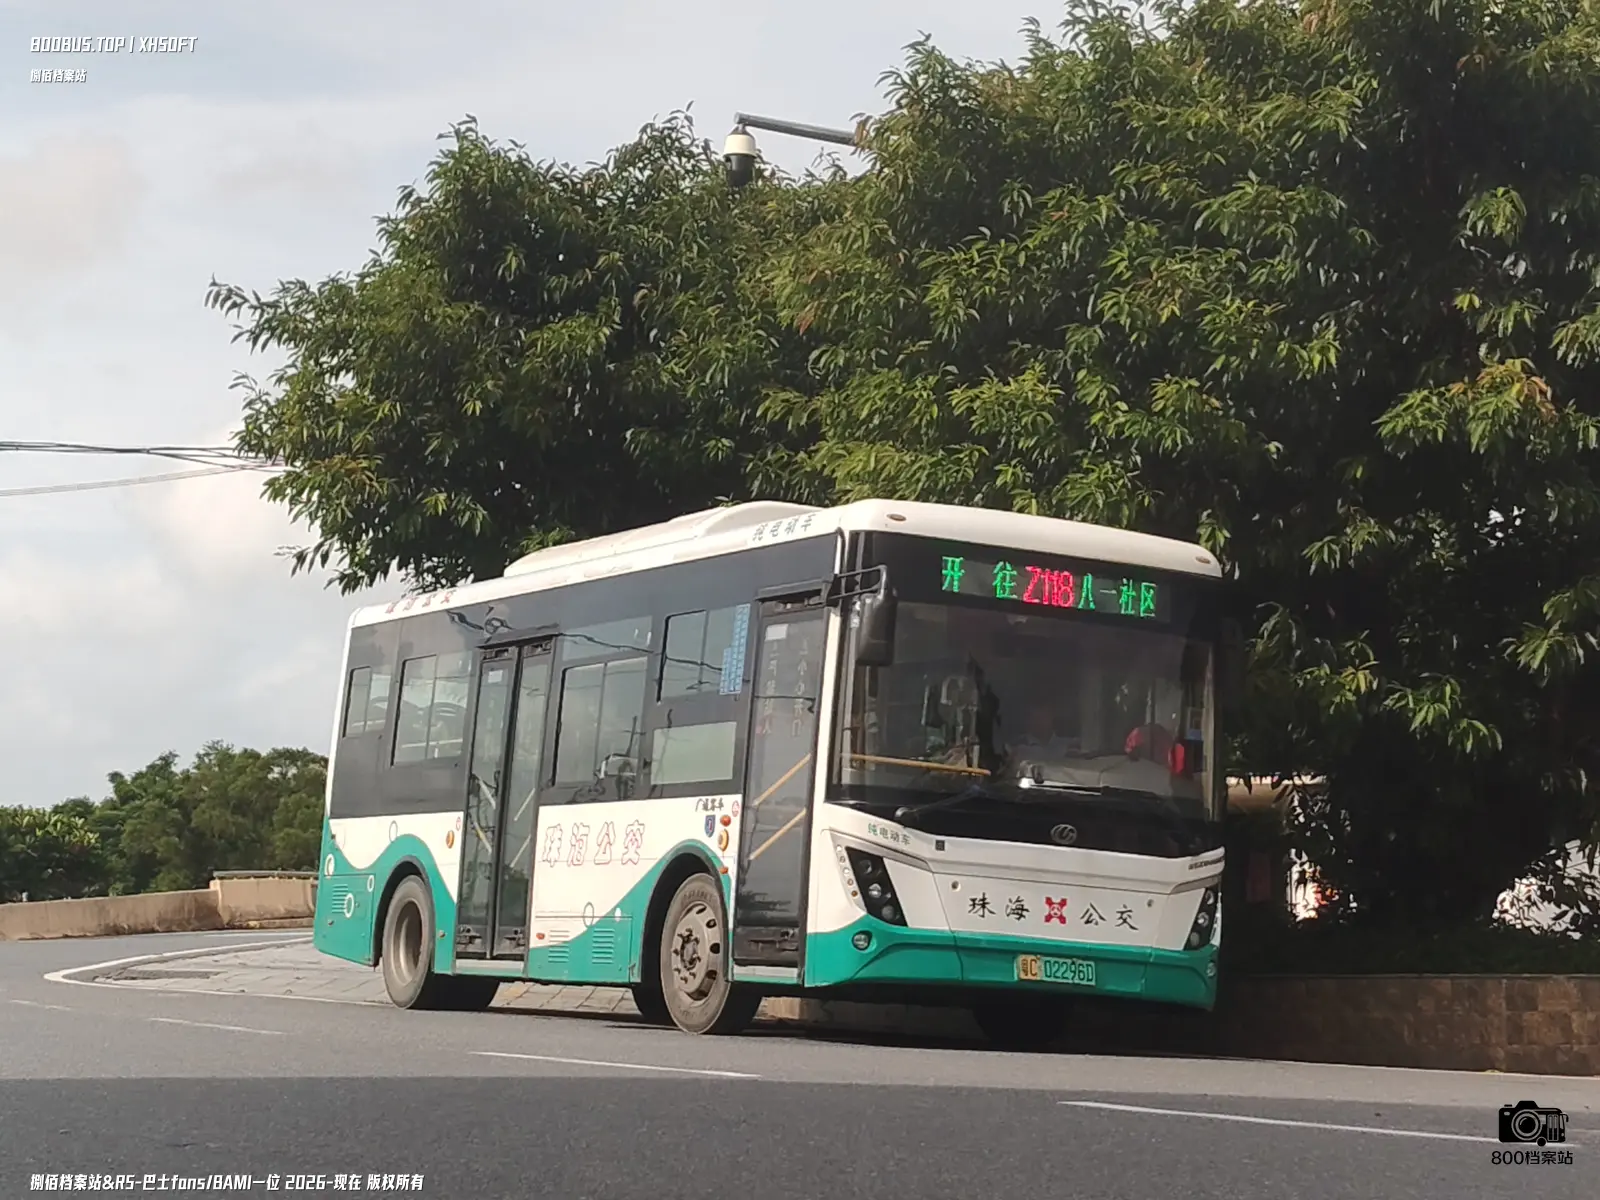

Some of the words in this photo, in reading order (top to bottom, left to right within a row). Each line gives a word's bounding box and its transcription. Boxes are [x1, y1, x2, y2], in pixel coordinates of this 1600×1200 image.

[1077, 572, 1157, 618] 八一社区
[868, 822, 911, 846] 纯电动车
